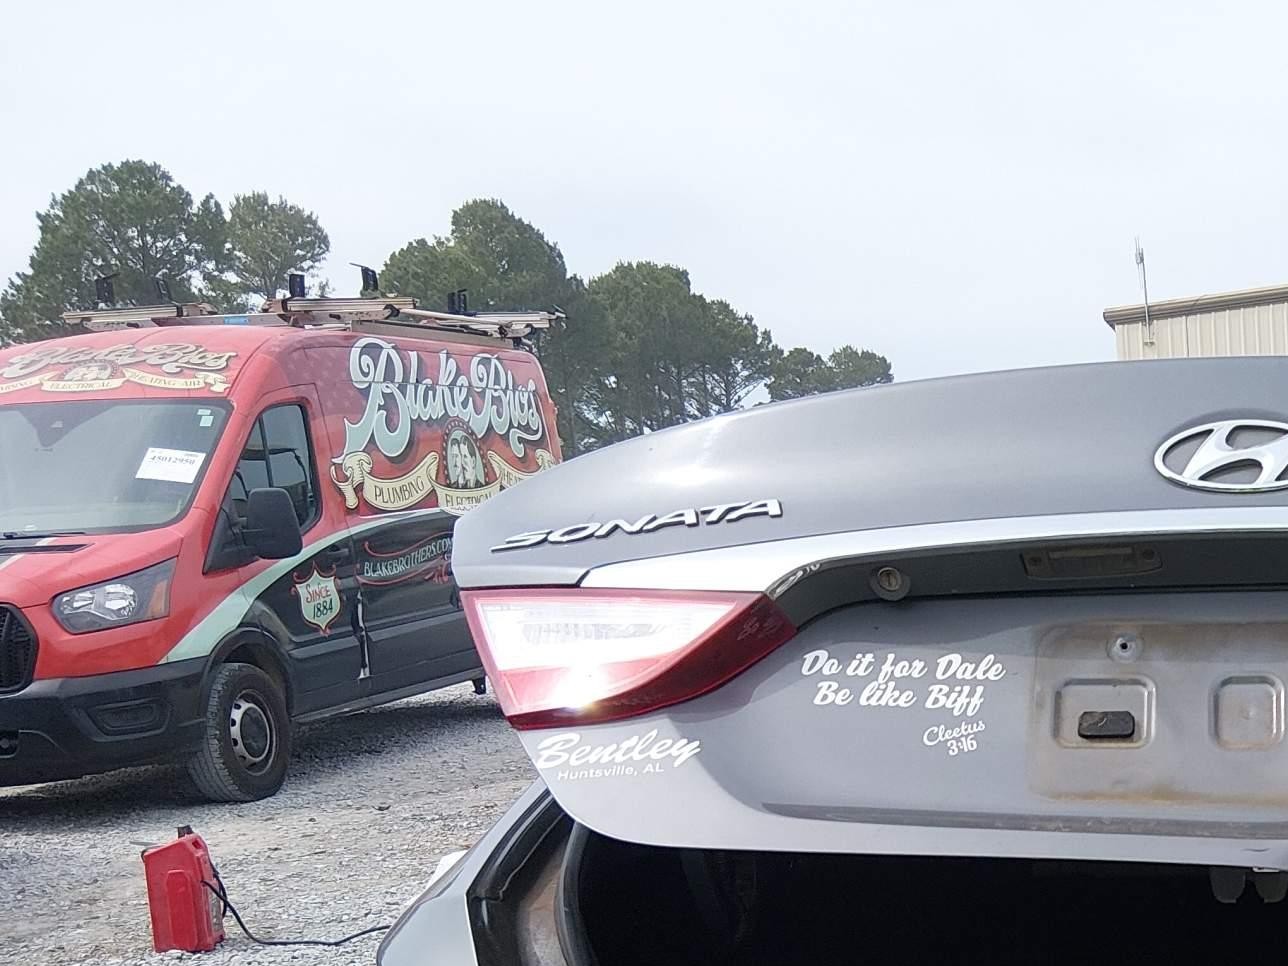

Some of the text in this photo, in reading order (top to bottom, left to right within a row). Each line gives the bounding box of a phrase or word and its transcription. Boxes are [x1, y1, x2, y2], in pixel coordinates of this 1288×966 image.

[332, 336, 543, 458] Blake Bros
[374, 475, 425, 504] PLUMBING
[490, 499, 782, 552] SONATA
[312, 602, 333, 620] 1884
[801, 650, 1006, 685] Do it for Dale
[813, 681, 985, 716] Be like Biff
[537, 729, 701, 768] Bentley
[923, 720, 986, 746] Cleetus
[947, 734, 977, 756] 3:16
[557, 763, 665, 781] Huntsville, AL
